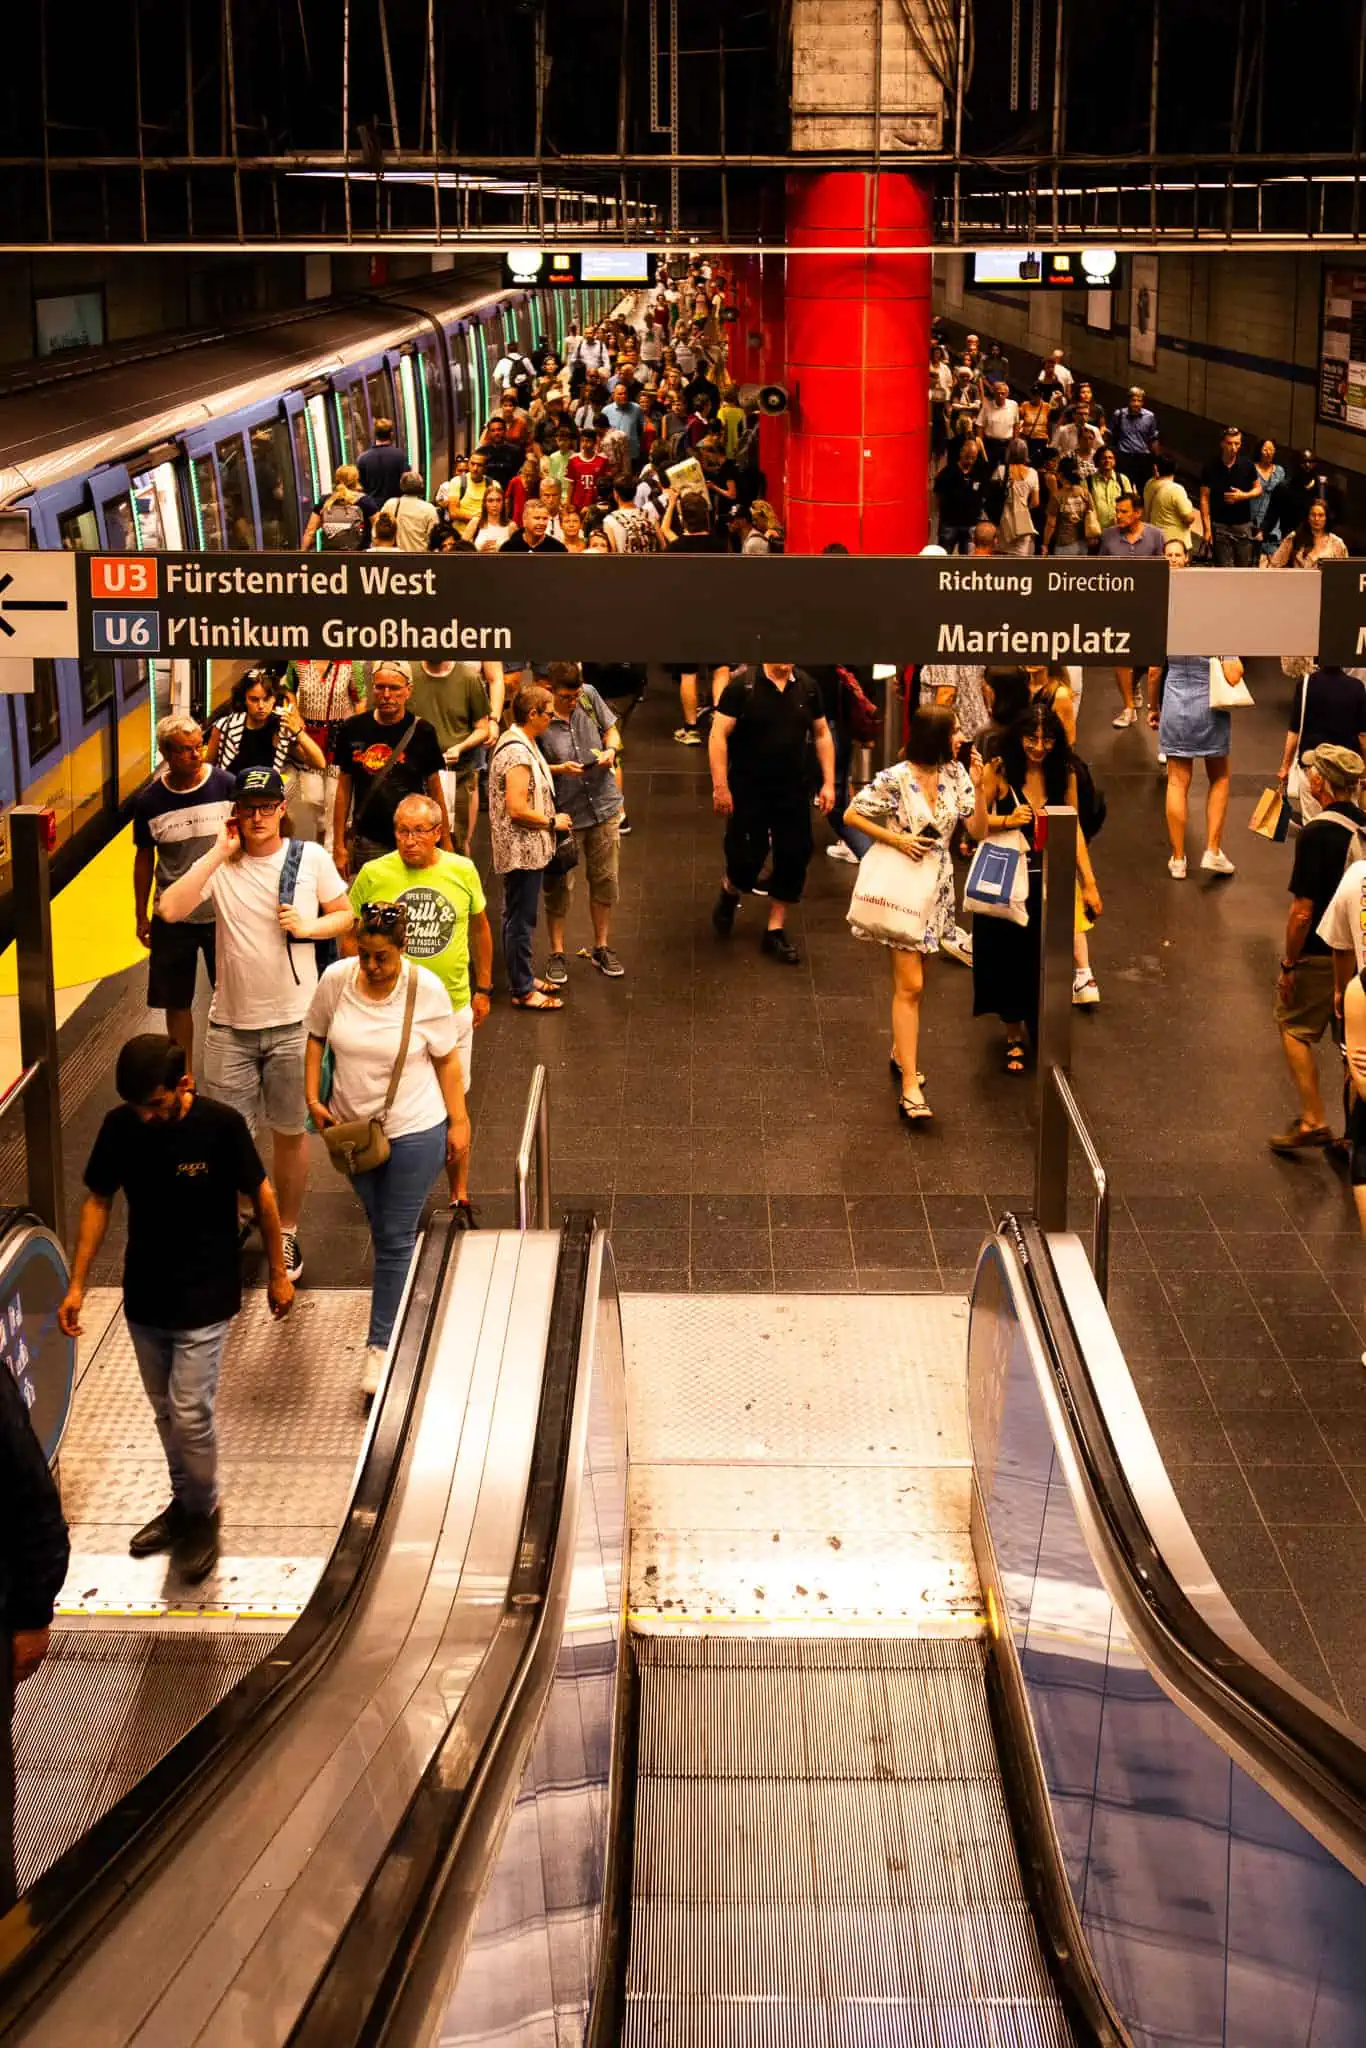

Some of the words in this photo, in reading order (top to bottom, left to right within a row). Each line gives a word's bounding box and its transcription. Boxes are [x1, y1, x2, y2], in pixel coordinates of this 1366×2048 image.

[581, 474, 594, 490] T
[103, 564, 146, 591] U3
[166, 563, 347, 594] Fürstenried
[359, 566, 436, 595] West
[939, 570, 1032, 595] Richtung
[1048, 571, 1134, 591] Direction
[105, 617, 149, 645] U6
[322, 618, 511, 649] Großhadern
[937, 623, 1131, 660] Marienplatz
[402, 901, 438, 922] rill
[439, 905, 455, 922] &
[405, 921, 441, 938] Chill
